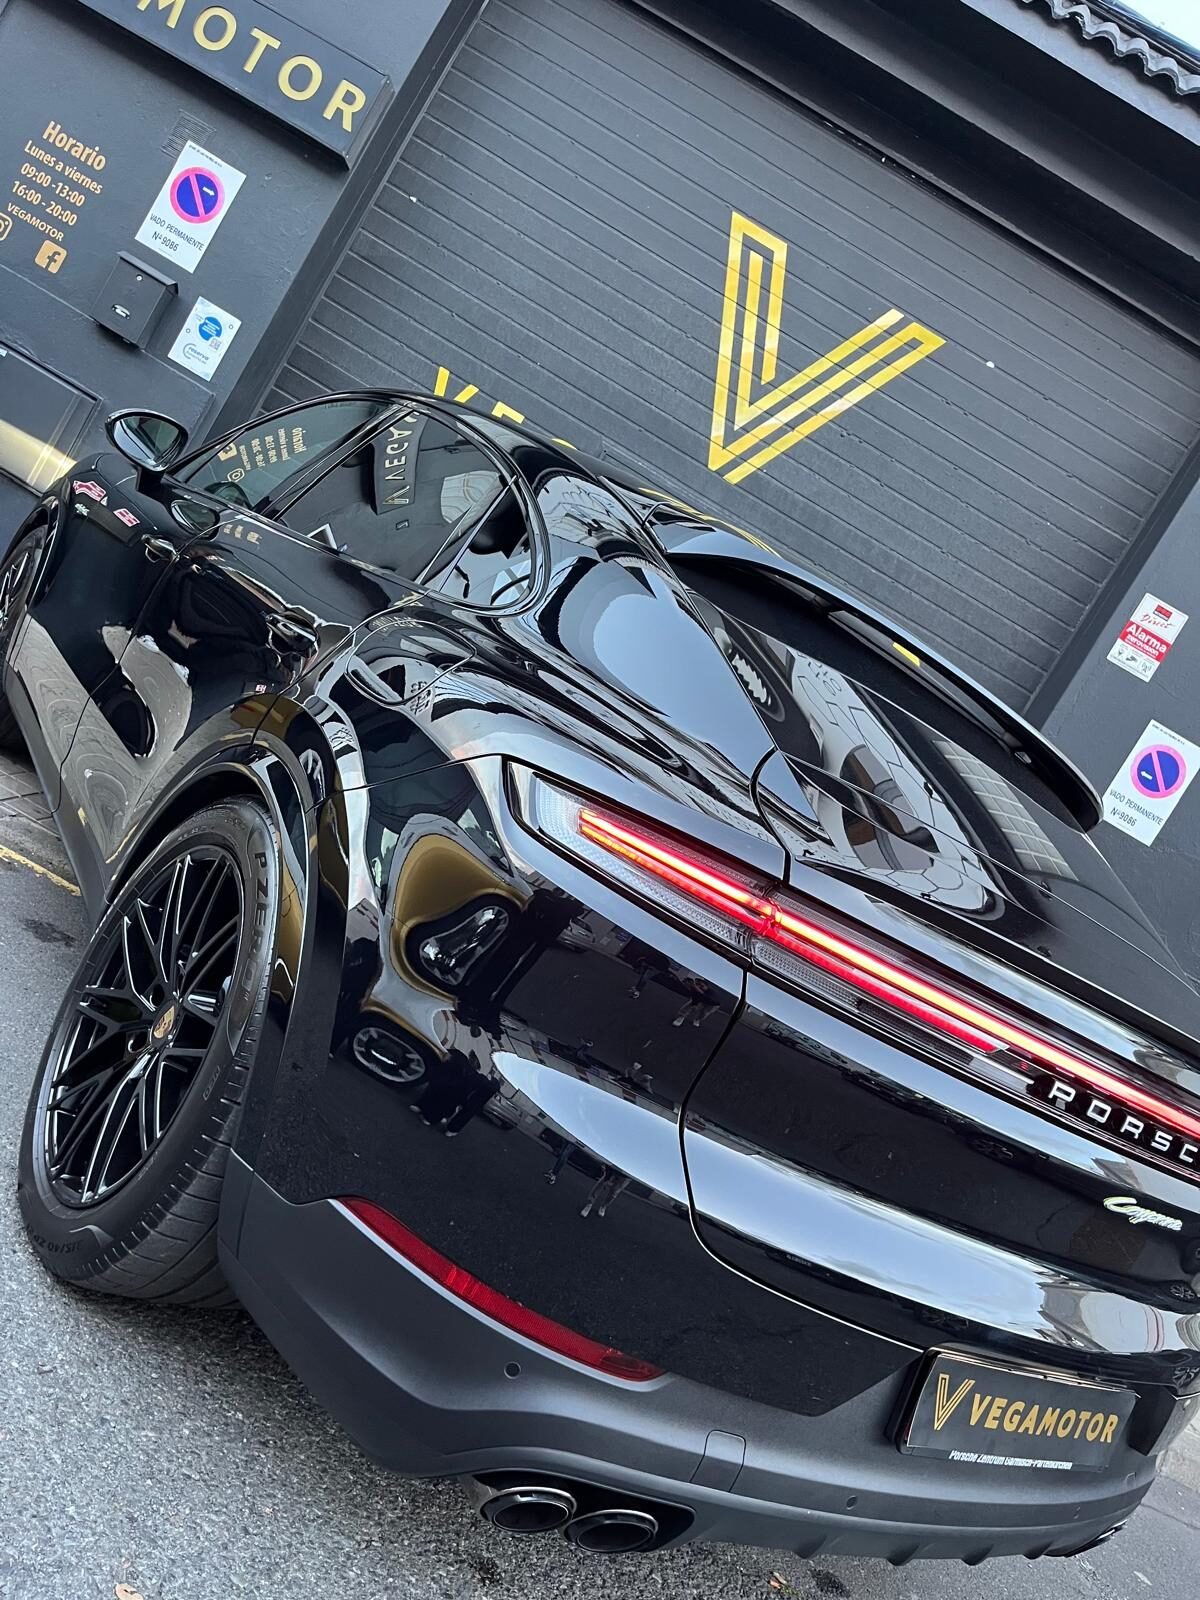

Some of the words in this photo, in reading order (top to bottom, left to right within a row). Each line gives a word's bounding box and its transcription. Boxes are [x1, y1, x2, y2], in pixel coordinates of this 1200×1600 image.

[42, 120, 106, 171] Horario
[21, 163, 52, 187] 09:00
[24, 140, 57, 168] Lunes
[55, 161, 64, 172] a
[64, 166, 103, 194] viernes
[7, 203, 64, 241] VEGAMOTOR
[12, 181, 42, 205] 16:00
[45, 201, 78, 226] 20:00
[150, 213, 166, 228] VADO
[166, 223, 205, 251] PERMANENTE
[1126, 623, 1168, 653] Alarma
[1109, 789, 1126, 803] VADO
[1125, 798, 1164, 826] PERMANENTE
[969, 1393, 1119, 1444] VEGAMOTOR
